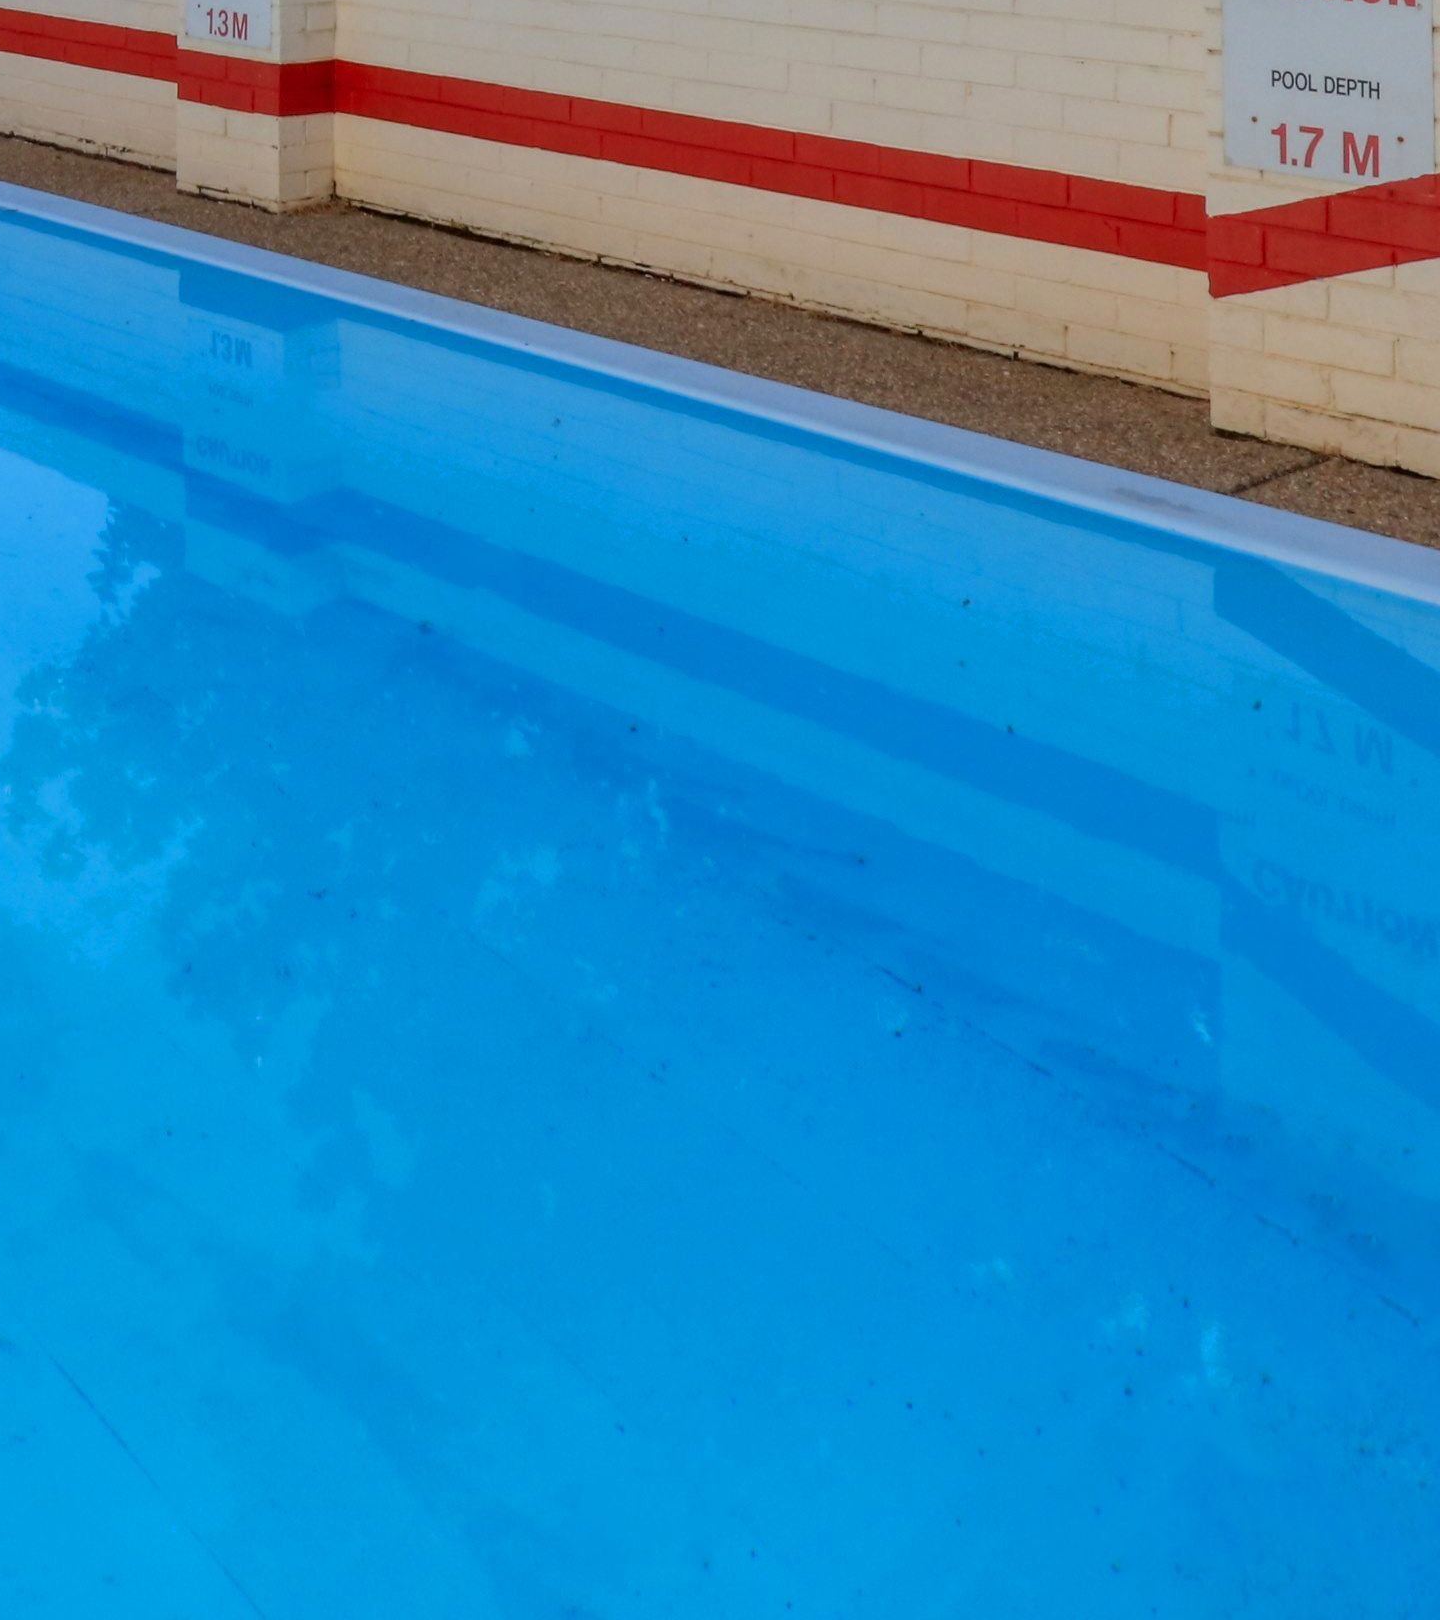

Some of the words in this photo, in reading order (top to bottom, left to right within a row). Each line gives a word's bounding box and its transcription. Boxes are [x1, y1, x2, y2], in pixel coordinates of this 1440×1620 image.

[206, 8, 229, 38] 1.3
[232, 12, 249, 41] M
[1271, 69, 1318, 93] POOL
[1324, 75, 1381, 100] DEPTH
[1271, 122, 1324, 169] 1.7
[1342, 131, 1380, 178] M
